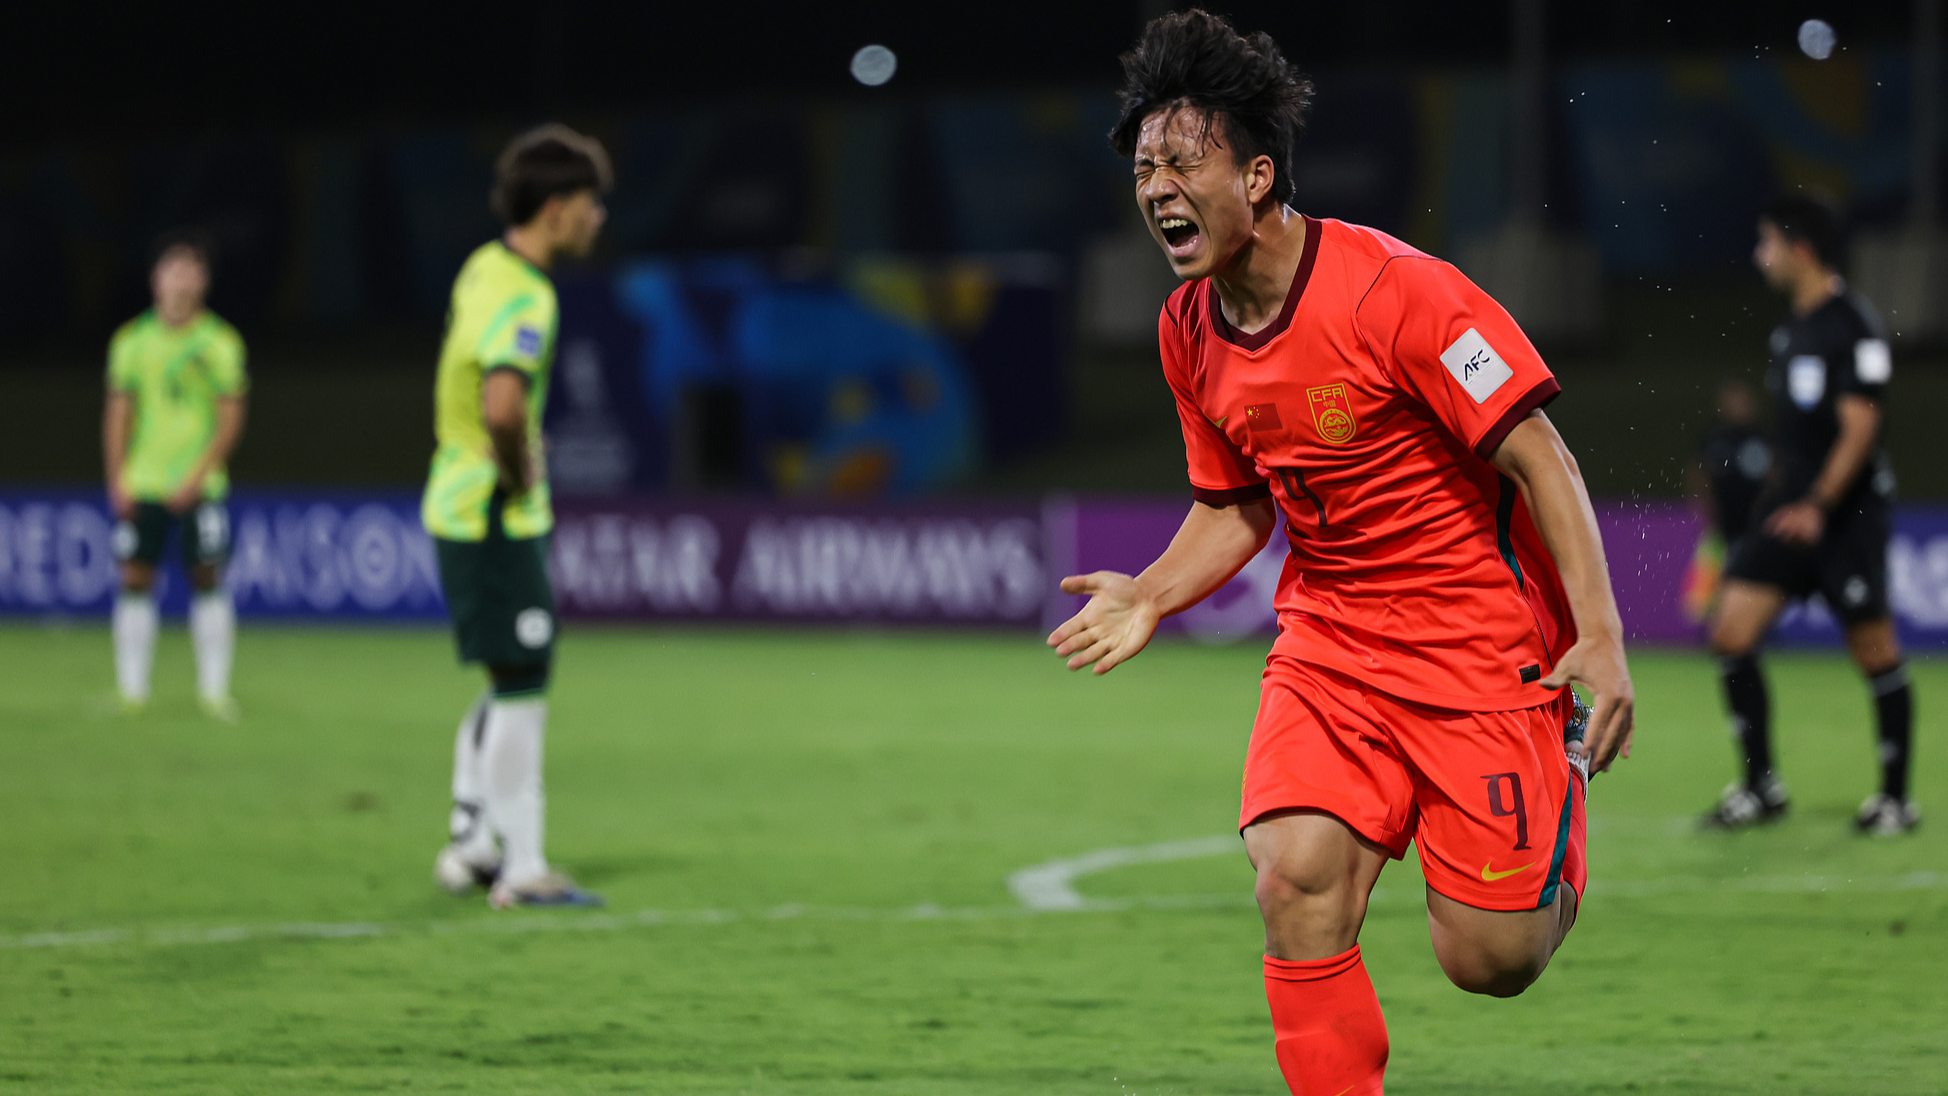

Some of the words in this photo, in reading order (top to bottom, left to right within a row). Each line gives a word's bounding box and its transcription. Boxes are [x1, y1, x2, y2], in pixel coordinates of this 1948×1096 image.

[1464, 349, 1490, 381] AFC
[1311, 387, 1343, 402] CFA
[731, 514, 1043, 618] AIRWAYS
[1480, 772, 1532, 851] 9
